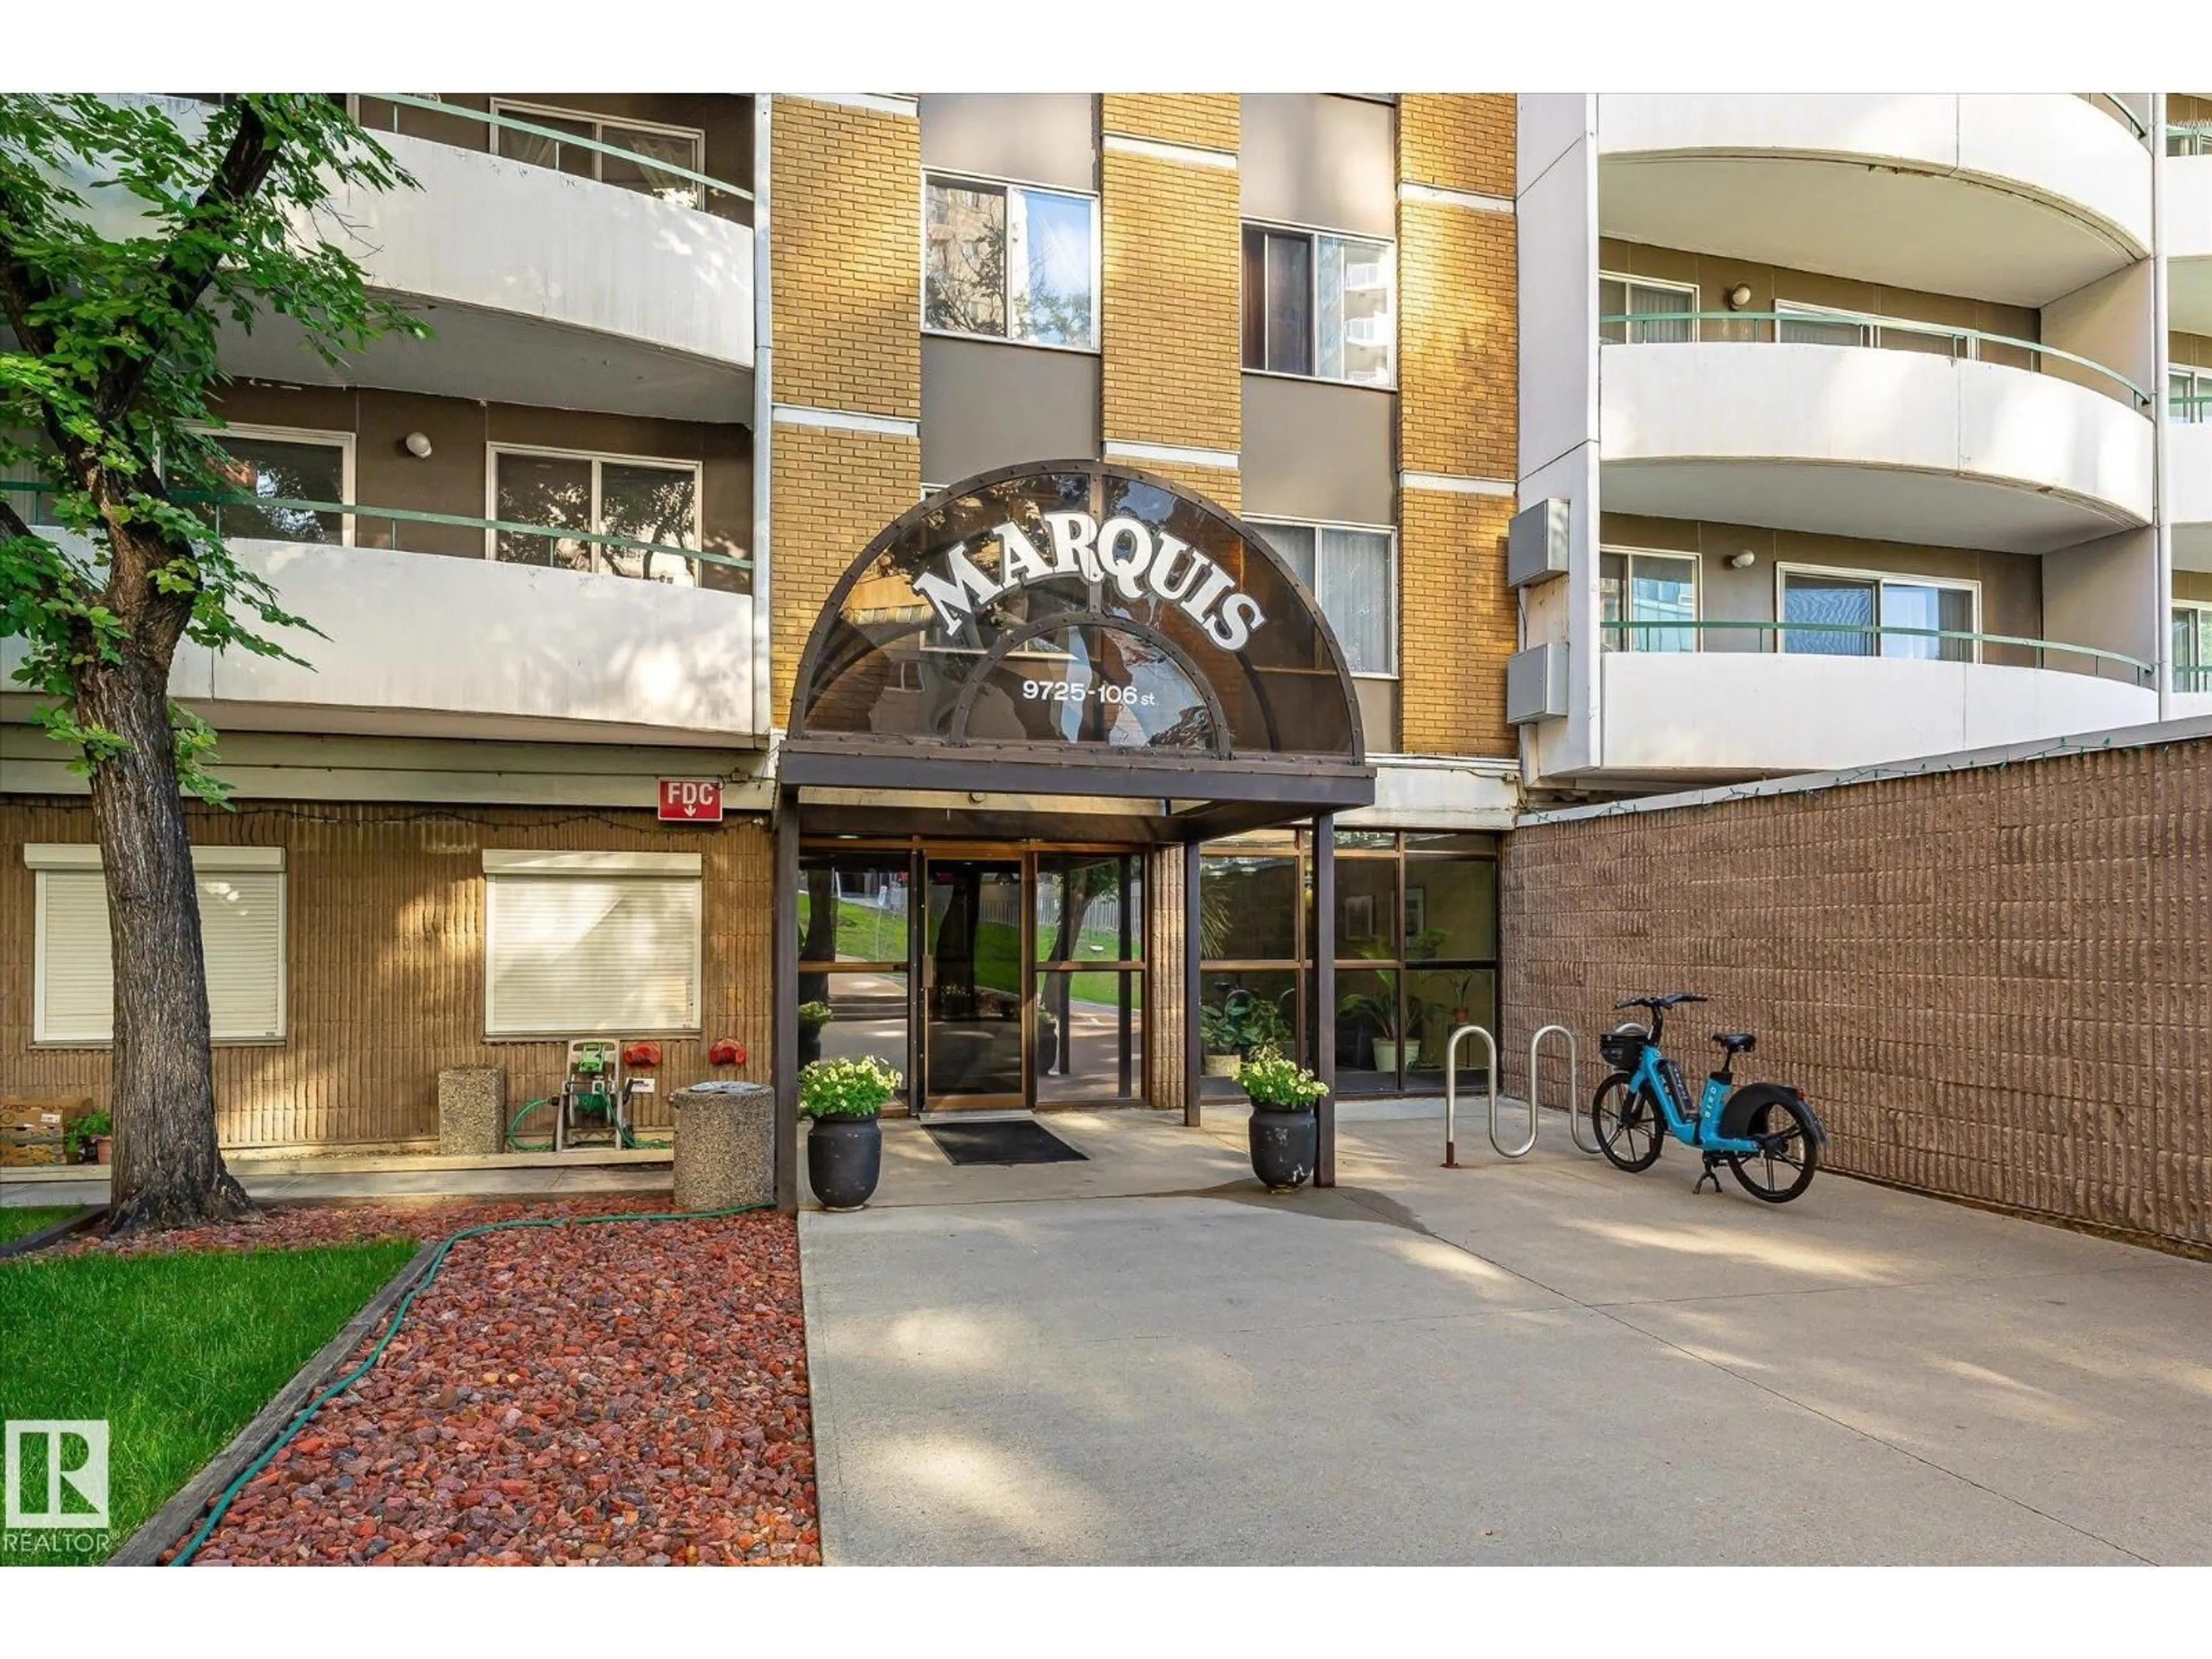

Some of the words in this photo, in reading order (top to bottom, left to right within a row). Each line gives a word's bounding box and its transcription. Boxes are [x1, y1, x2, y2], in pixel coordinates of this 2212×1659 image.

[912, 510, 1267, 652] MARQUIS
[1022, 680, 1138, 705] 9725-106
[668, 782, 713, 805] FDC
